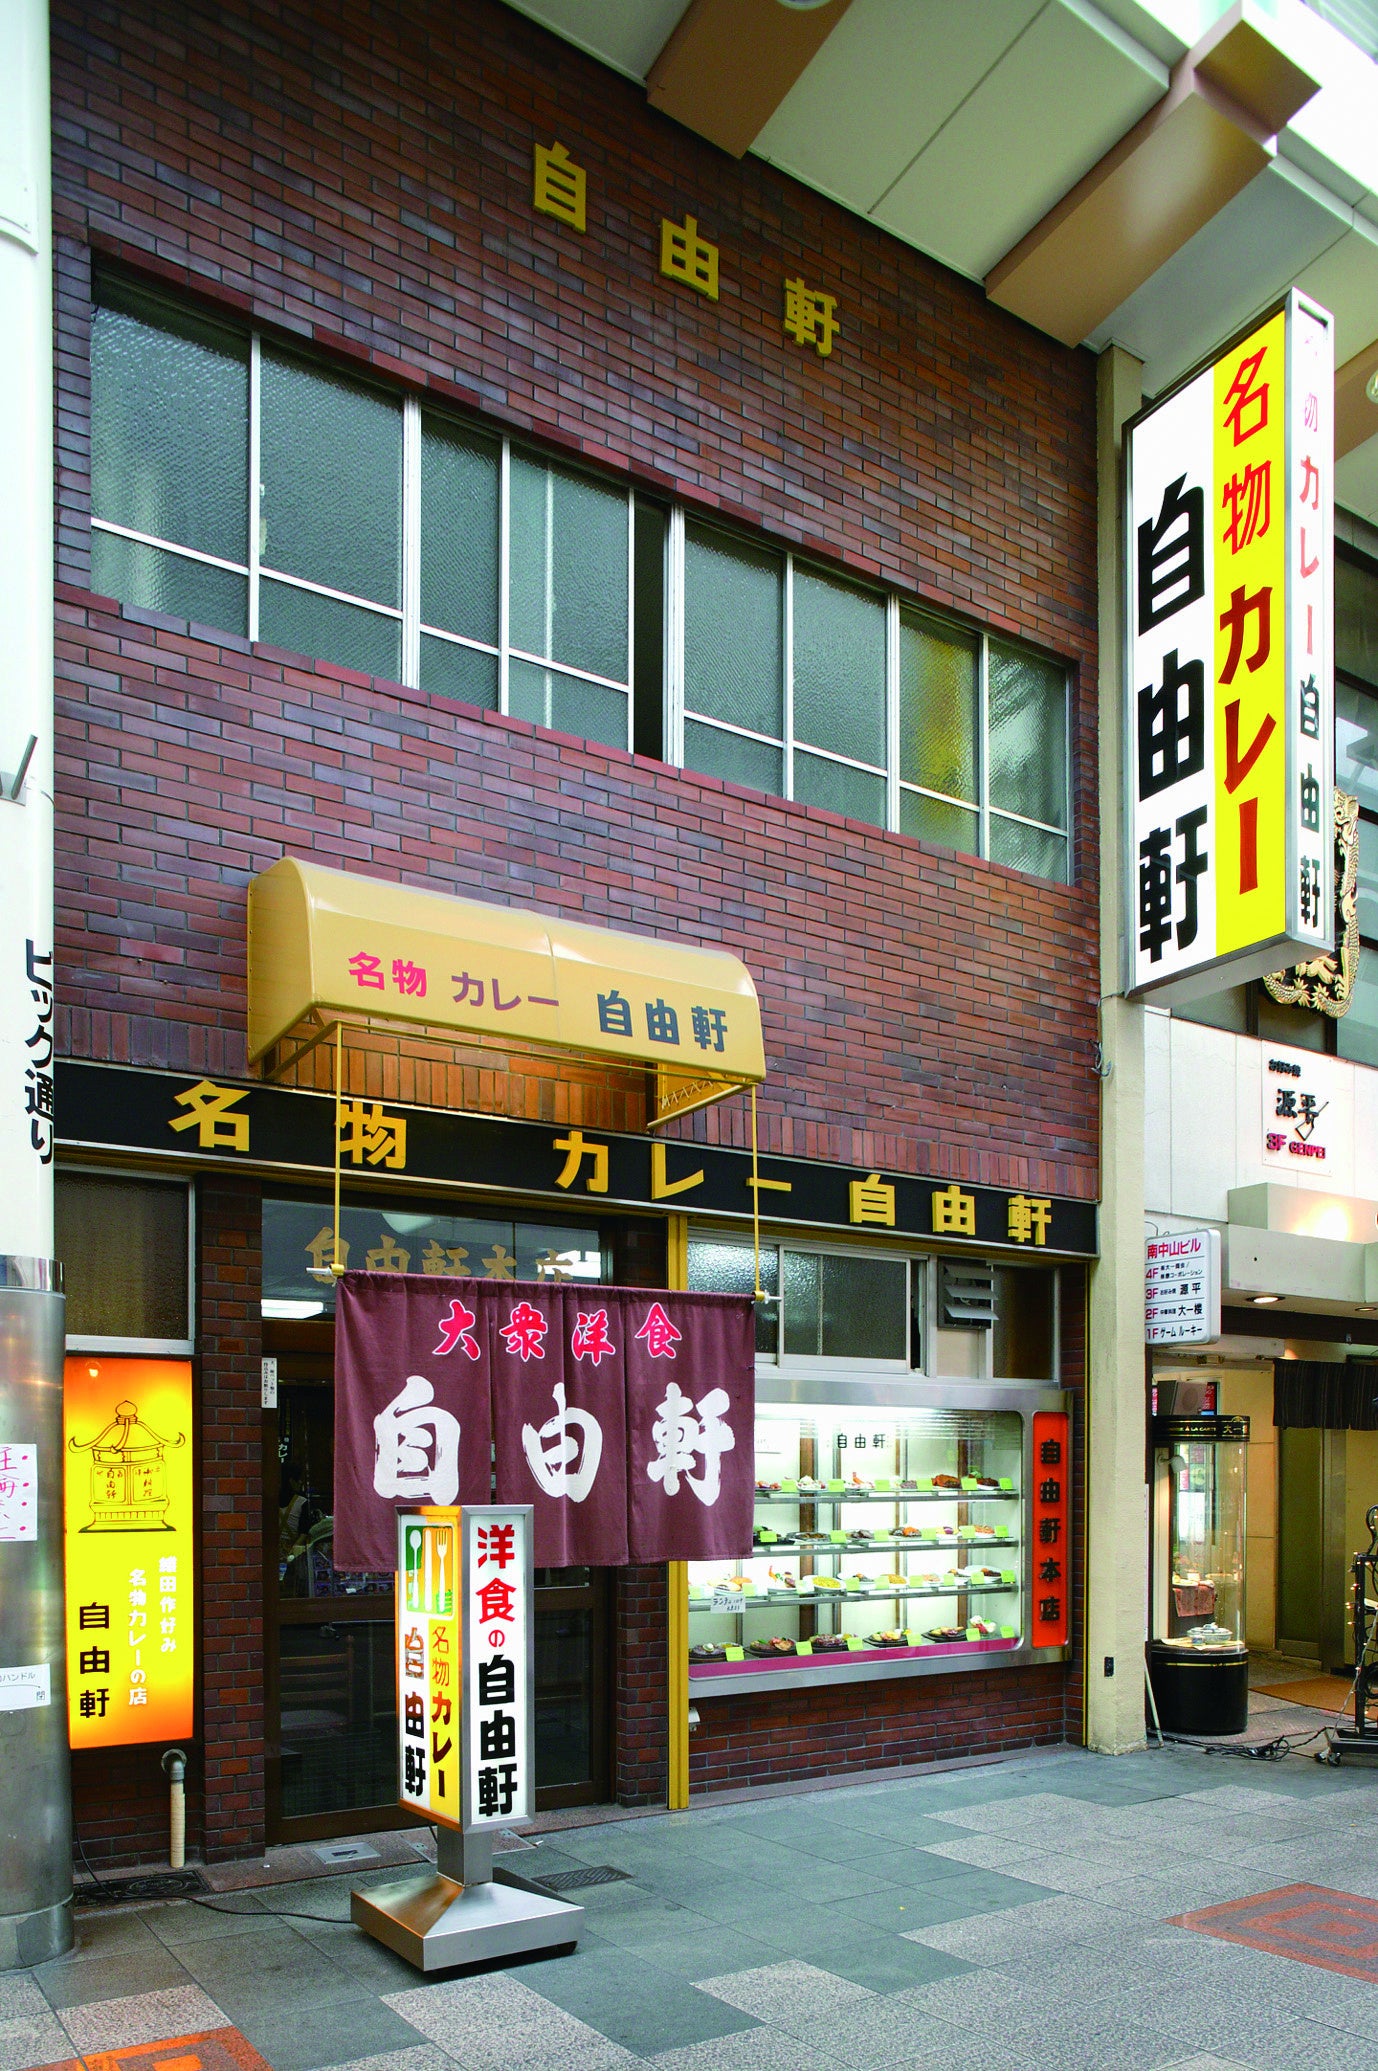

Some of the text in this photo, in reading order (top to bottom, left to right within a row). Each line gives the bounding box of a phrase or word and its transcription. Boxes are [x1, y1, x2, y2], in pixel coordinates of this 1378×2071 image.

[533, 140, 840, 357] 自由軒
[1218, 346, 1277, 896] 名物カレー
[1137, 472, 1208, 962] 自由軒
[1300, 674, 1321, 928] 自由軒
[597, 990, 729, 1053] 自由軒
[1289, 1141, 1326, 1159] GENPEI
[849, 1174, 1052, 1246] 自由軒
[1147, 1237, 1201, 1260] 南中山ビル
[1145, 1267, 1159, 1280] 4F
[1145, 1287, 1159, 1299] 3F
[1180, 1282, 1202, 1296] 源平
[1145, 1308, 1159, 1320] 2F
[432, 1299, 682, 1367] 大衆洋食
[1146, 1328, 1159, 1340] 1F
[1178, 1325, 1203, 1337] ルーキー
[373, 1375, 735, 1507] 自由軒
[837, 1432, 886, 1449] 自由軒
[1039, 1439, 1062, 1622] 自由軒本店
[78, 1602, 110, 1718] 自由軒
[128, 1568, 147, 1706] 名物カレーの店
[404, 1627, 426, 1797] 自由軒
[431, 1626, 453, 1798] 名物カレー
